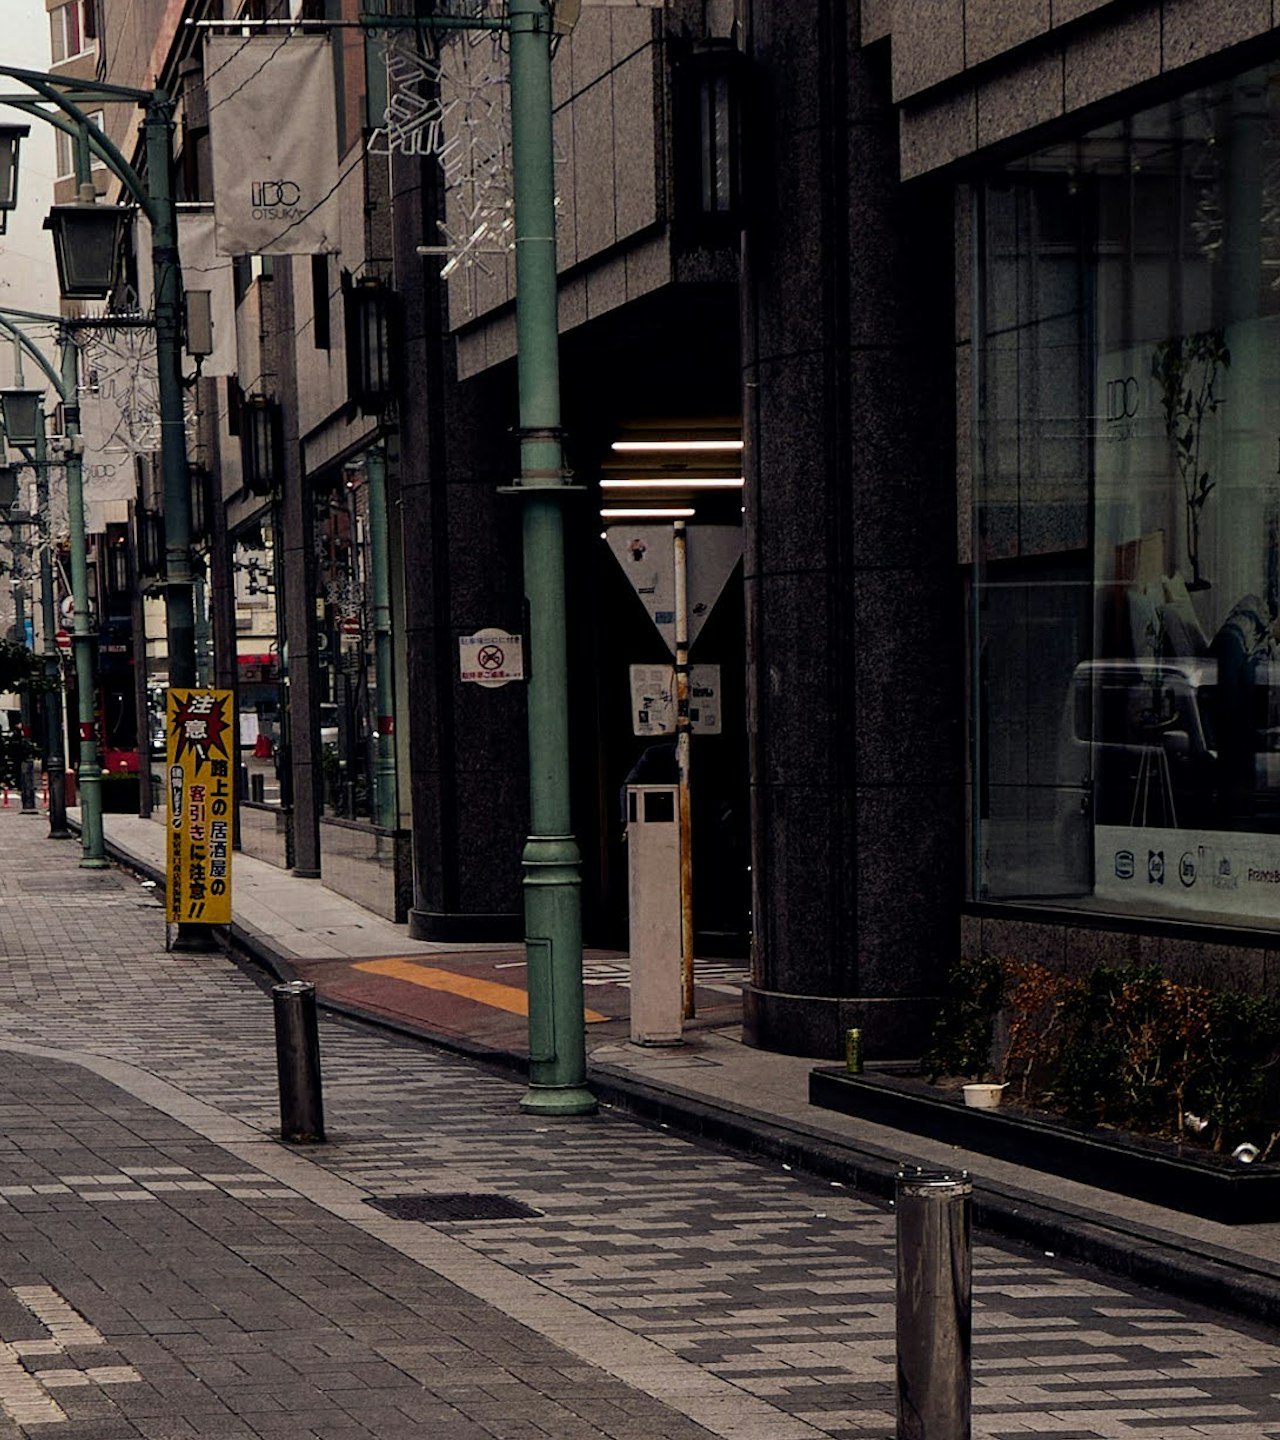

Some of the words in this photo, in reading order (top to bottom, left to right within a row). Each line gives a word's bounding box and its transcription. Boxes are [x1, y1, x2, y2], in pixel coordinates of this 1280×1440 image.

[251, 181, 300, 207] IDC
[210, 759, 227, 896] 路上の居酒屋の
